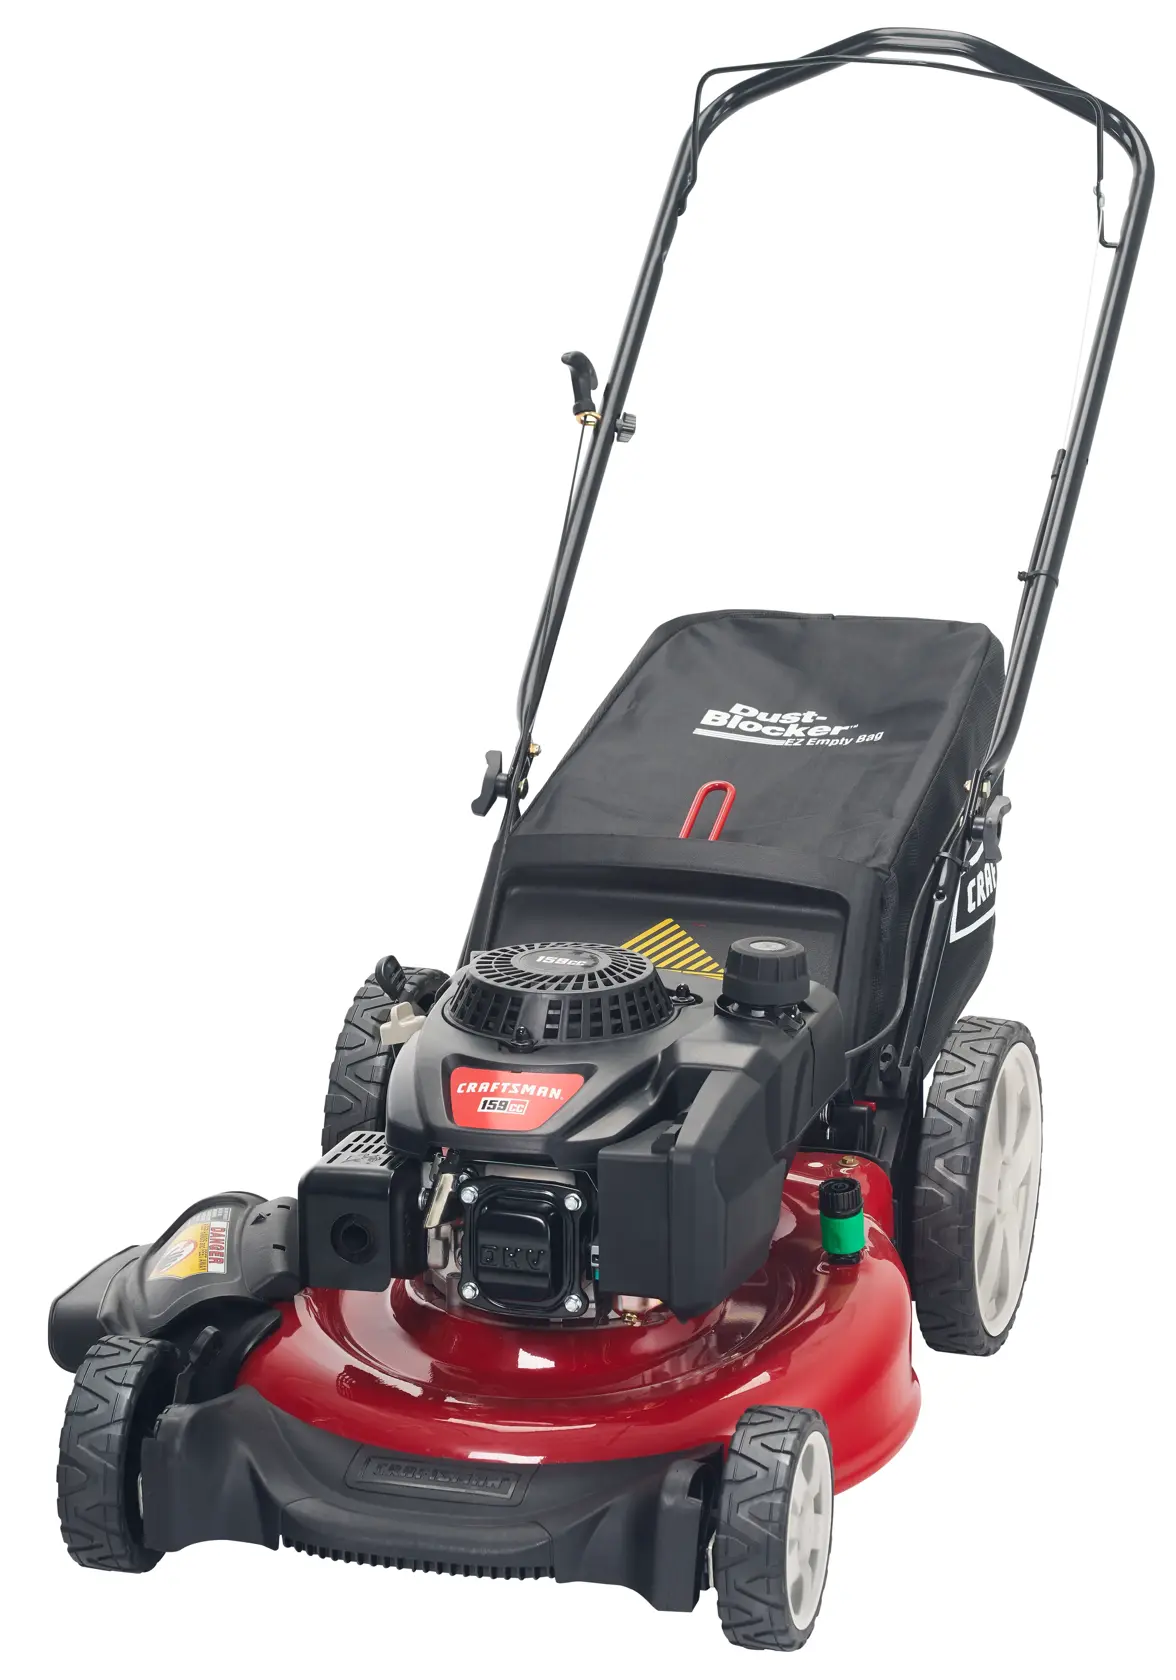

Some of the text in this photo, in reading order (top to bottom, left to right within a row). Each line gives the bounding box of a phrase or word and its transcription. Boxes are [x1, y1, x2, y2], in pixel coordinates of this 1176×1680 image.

[729, 702, 828, 724] Dust-
[784, 731, 885, 747] EZ Empty Bag
[208, 1227, 225, 1264] DANGER
